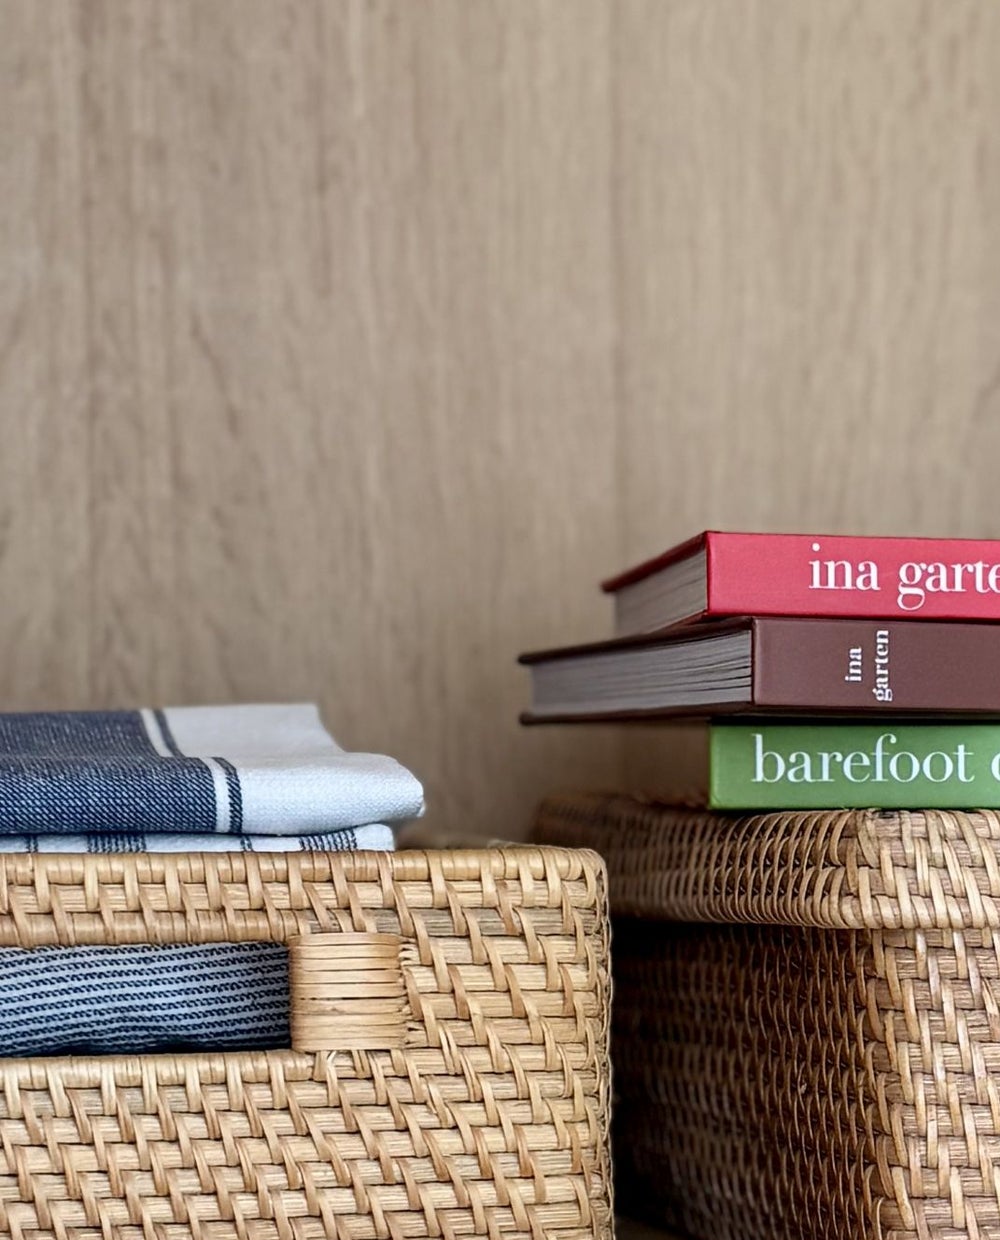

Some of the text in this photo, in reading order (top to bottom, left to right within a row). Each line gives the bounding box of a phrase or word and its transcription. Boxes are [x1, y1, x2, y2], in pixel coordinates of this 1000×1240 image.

[808, 542, 881, 591] ina
[844, 647, 862, 682] ina
[872, 630, 893, 701] garten
[751, 732, 975, 784] barefoot
